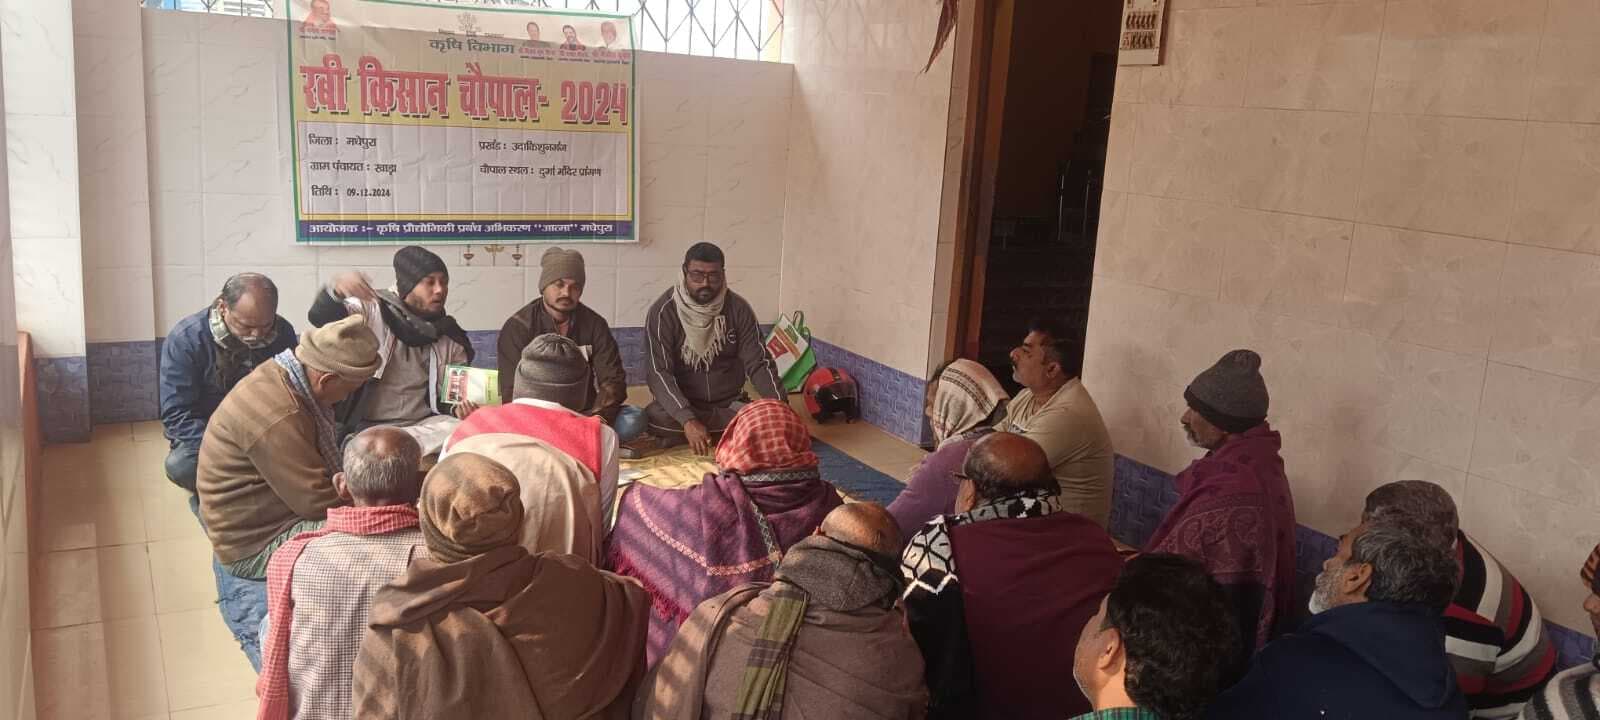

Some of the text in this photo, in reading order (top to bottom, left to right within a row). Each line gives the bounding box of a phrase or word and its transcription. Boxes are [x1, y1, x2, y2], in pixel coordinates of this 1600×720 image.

[429, 37, 462, 53] कृषि
[467, 39, 514, 54] विभाग
[300, 53, 351, 115] रबी
[357, 55, 450, 119] किसान
[561, 80, 629, 126] 2024
[308, 133, 333, 146] जिला
[346, 135, 377, 150] मधेपुरा
[479, 139, 501, 151] प्रखंड
[310, 161, 330, 171] ग्राम
[332, 159, 364, 172] पंचायत
[480, 163, 506, 174] चौपाल
[508, 166, 529, 175] स्थल
[539, 165, 556, 178] दुर्गा
[557, 165, 577, 177] मंदिर
[311, 185, 332, 197] तिथि
[346, 188, 391, 197] 09.12.2024
[309, 222, 358, 233] आयोजक
[376, 223, 400, 235] कृषि
[484, 222, 531, 232] अभिकरण
[580, 222, 613, 235] मधेपुरा
